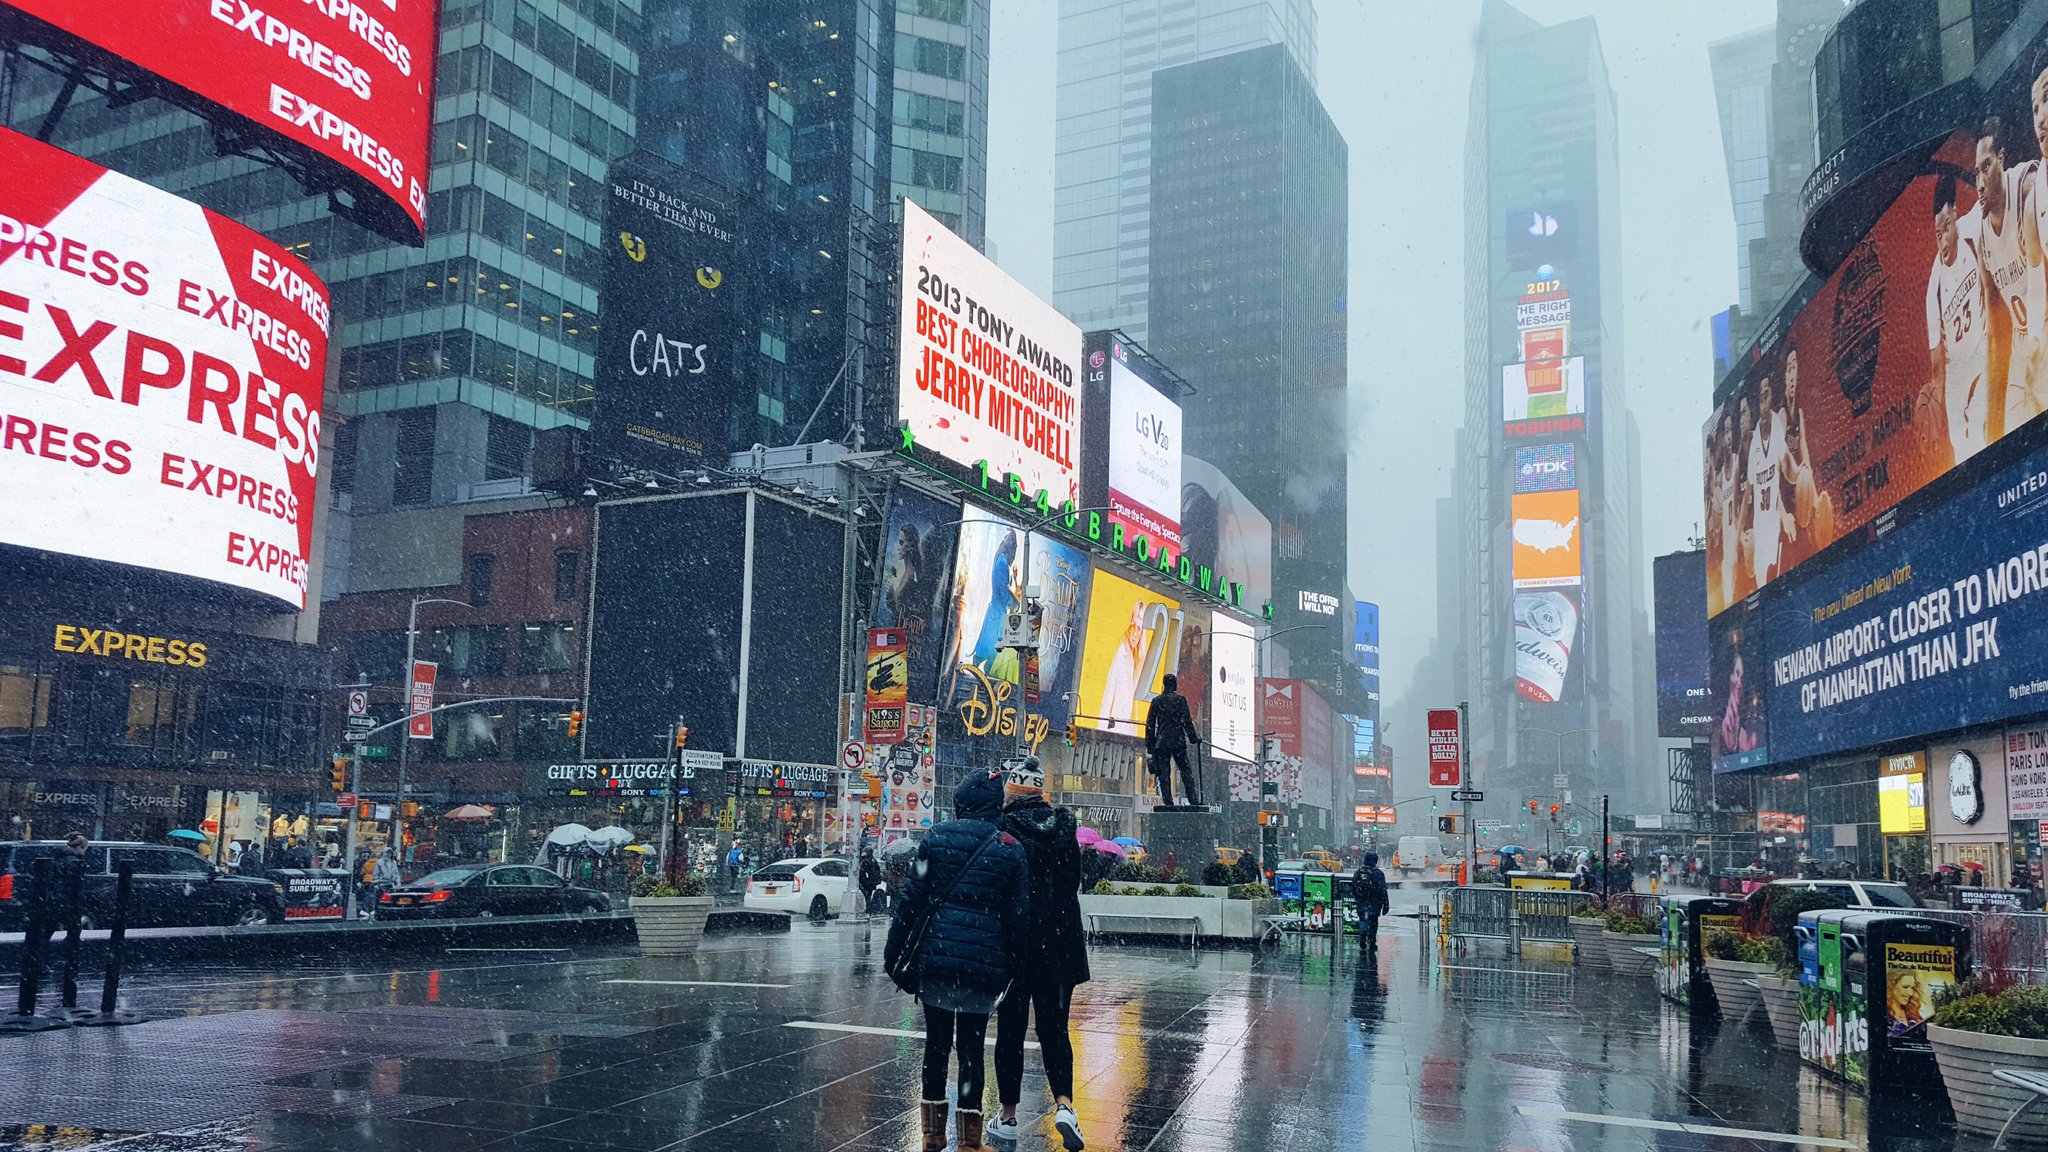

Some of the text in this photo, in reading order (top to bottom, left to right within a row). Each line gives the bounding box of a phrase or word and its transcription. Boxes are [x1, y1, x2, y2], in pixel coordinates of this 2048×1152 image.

[210, 0, 371, 100] EXPRESS
[269, 83, 403, 189] EXPRESS
[658, 190, 689, 213] BACK
[691, 206, 716, 224] AND
[663, 205, 697, 228] THAN
[1527, 279, 1560, 295] 2017
[177, 279, 311, 370] EXPRESS
[917, 264, 1074, 388] 2013 TONY AWARD
[1953, 298, 1972, 343] 23
[629, 328, 708, 377] CATS
[916, 297, 1076, 427] BEST CHOREOGRAPHY!
[1089, 374, 1104, 383] LG
[915, 345, 1073, 471] JERRY MITCHELL
[1135, 411, 1150, 440] LG
[1504, 418, 1584, 437] TOSHIBA
[1533, 460, 1568, 474] TDK
[160, 452, 299, 525] EXPRESS
[1997, 471, 2048, 508] UNITED
[1760, 486, 1772, 512] 30
[1875, 507, 1899, 527] MARRIOTT
[1875, 519, 1897, 537] MARQUIS
[227, 531, 309, 593] EXPRESS
[1089, 511, 1245, 607] BROADWAY
[1303, 591, 1339, 608] THE OFFERS
[1813, 606, 1826, 625] The
[1825, 602, 1841, 618] new
[1841, 586, 1864, 611] United
[1873, 578, 1891, 597] New
[1890, 562, 1912, 588] York
[1303, 601, 1322, 613] WILL
[1773, 545, 2048, 688] NEWARK AIRPORT: CLOSER TO MORE
[54, 624, 208, 668] EXPRESS
[1801, 616, 2000, 714] OF MANHATTAN THAN JFK
[1686, 688, 1706, 697] ONE
[2019, 683, 2031, 696] the
[1221, 690, 1248, 712] VISIT US
[870, 717, 900, 730] Saigon
[1431, 729, 1457, 737] BETTE
[1429, 736, 1458, 744] MIDLER
[2009, 753, 2033, 771] PARIS
[547, 764, 597, 780] GIFTS
[740, 763, 829, 782] GIFTS LUGGAGE
[2011, 771, 2047, 788] HONG KONG
[35, 792, 97, 805] EXPRESS
[130, 795, 188, 808] EXPRESS
[620, 789, 645, 797] SONY
[2020, 788, 2044, 799] ANGELES
[1087, 806, 1115, 821] FOREVER
[289, 878, 338, 886] BROADWAY'S
[1961, 891, 2016, 900] BROADWAY'S
[1916, 964, 1931, 972] King
